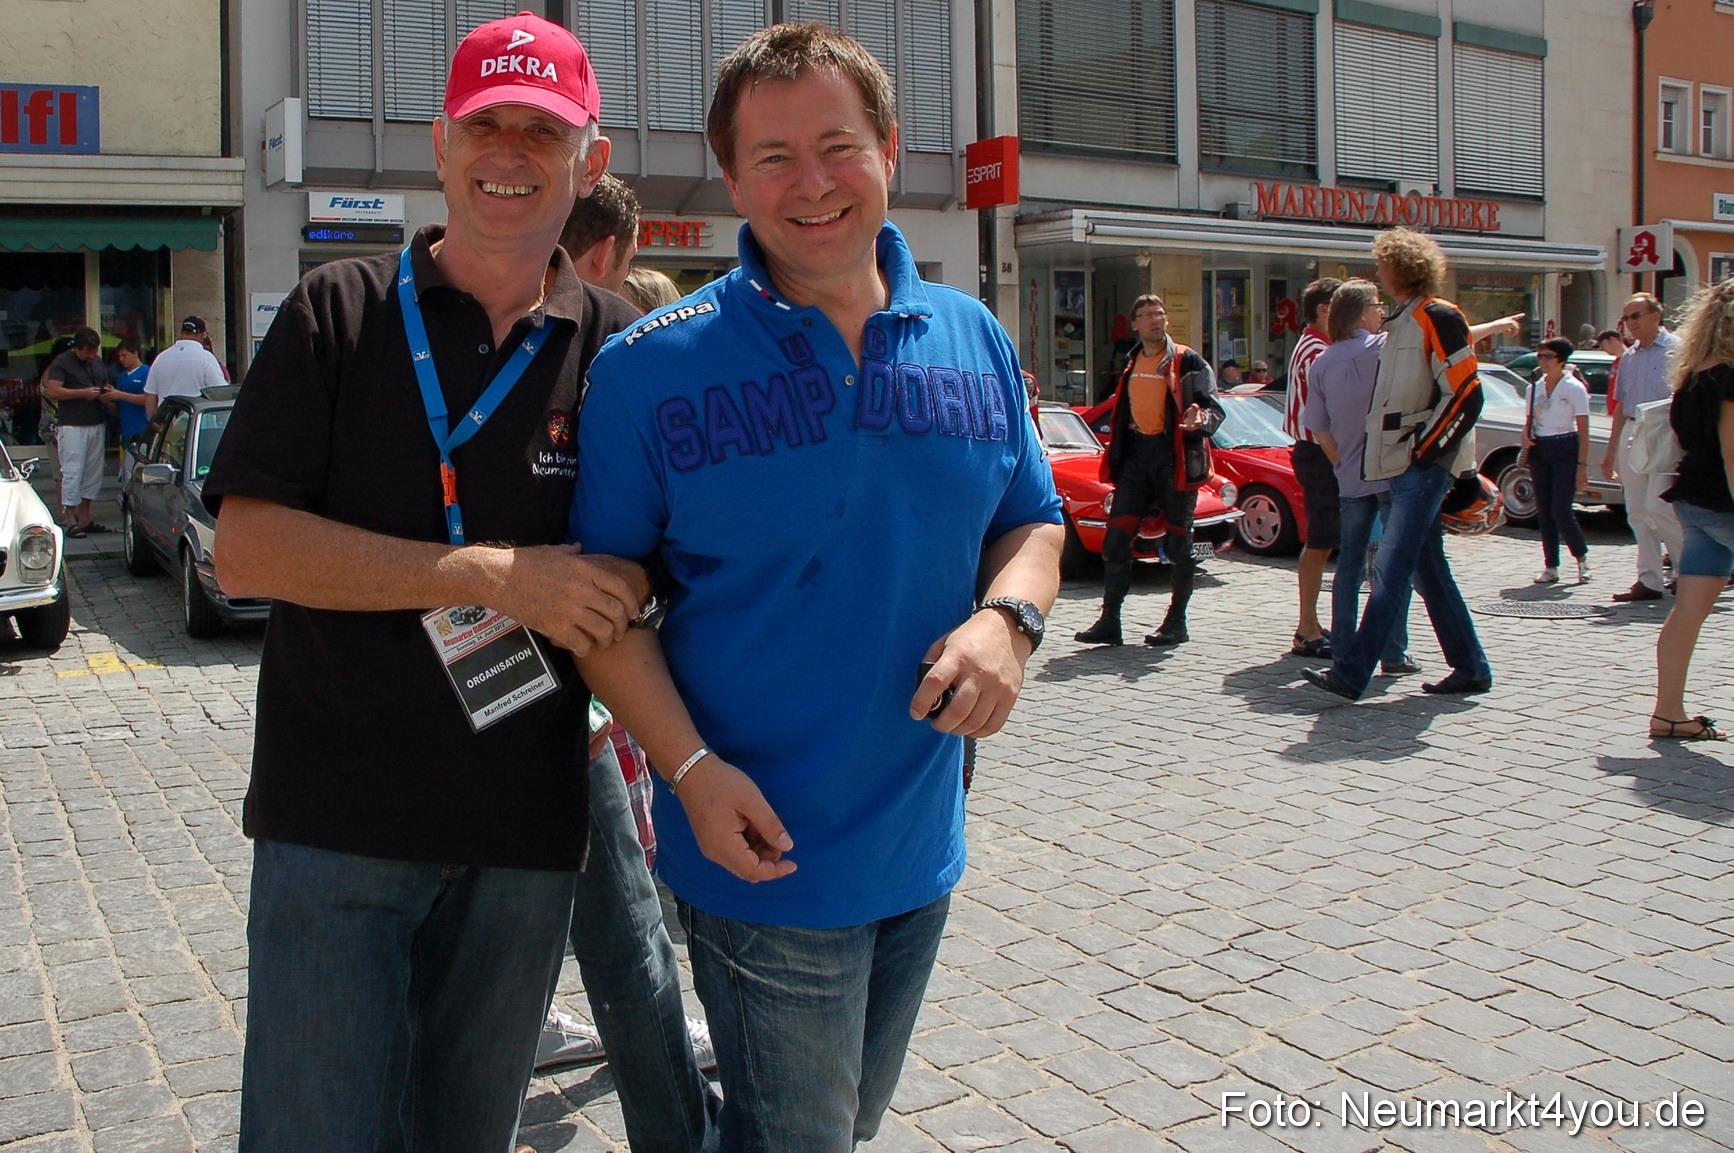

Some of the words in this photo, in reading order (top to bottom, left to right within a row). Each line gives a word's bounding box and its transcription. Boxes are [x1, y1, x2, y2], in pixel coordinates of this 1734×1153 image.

[480, 55, 558, 82] DEKRA
[269, 134, 283, 150] Fürst
[967, 162, 1002, 185] ESPRIT
[329, 197, 385, 209] Fürst
[1254, 181, 1501, 231] MARIEN-APOTHEKE
[637, 219, 706, 247] SPRIT
[1002, 262, 1012, 273] 38
[539, 451, 553, 463] Ich
[466, 647, 533, 689] ORGANISATION
[484, 697, 512, 718] Manfred
[511, 680, 545, 702] Schreiner
